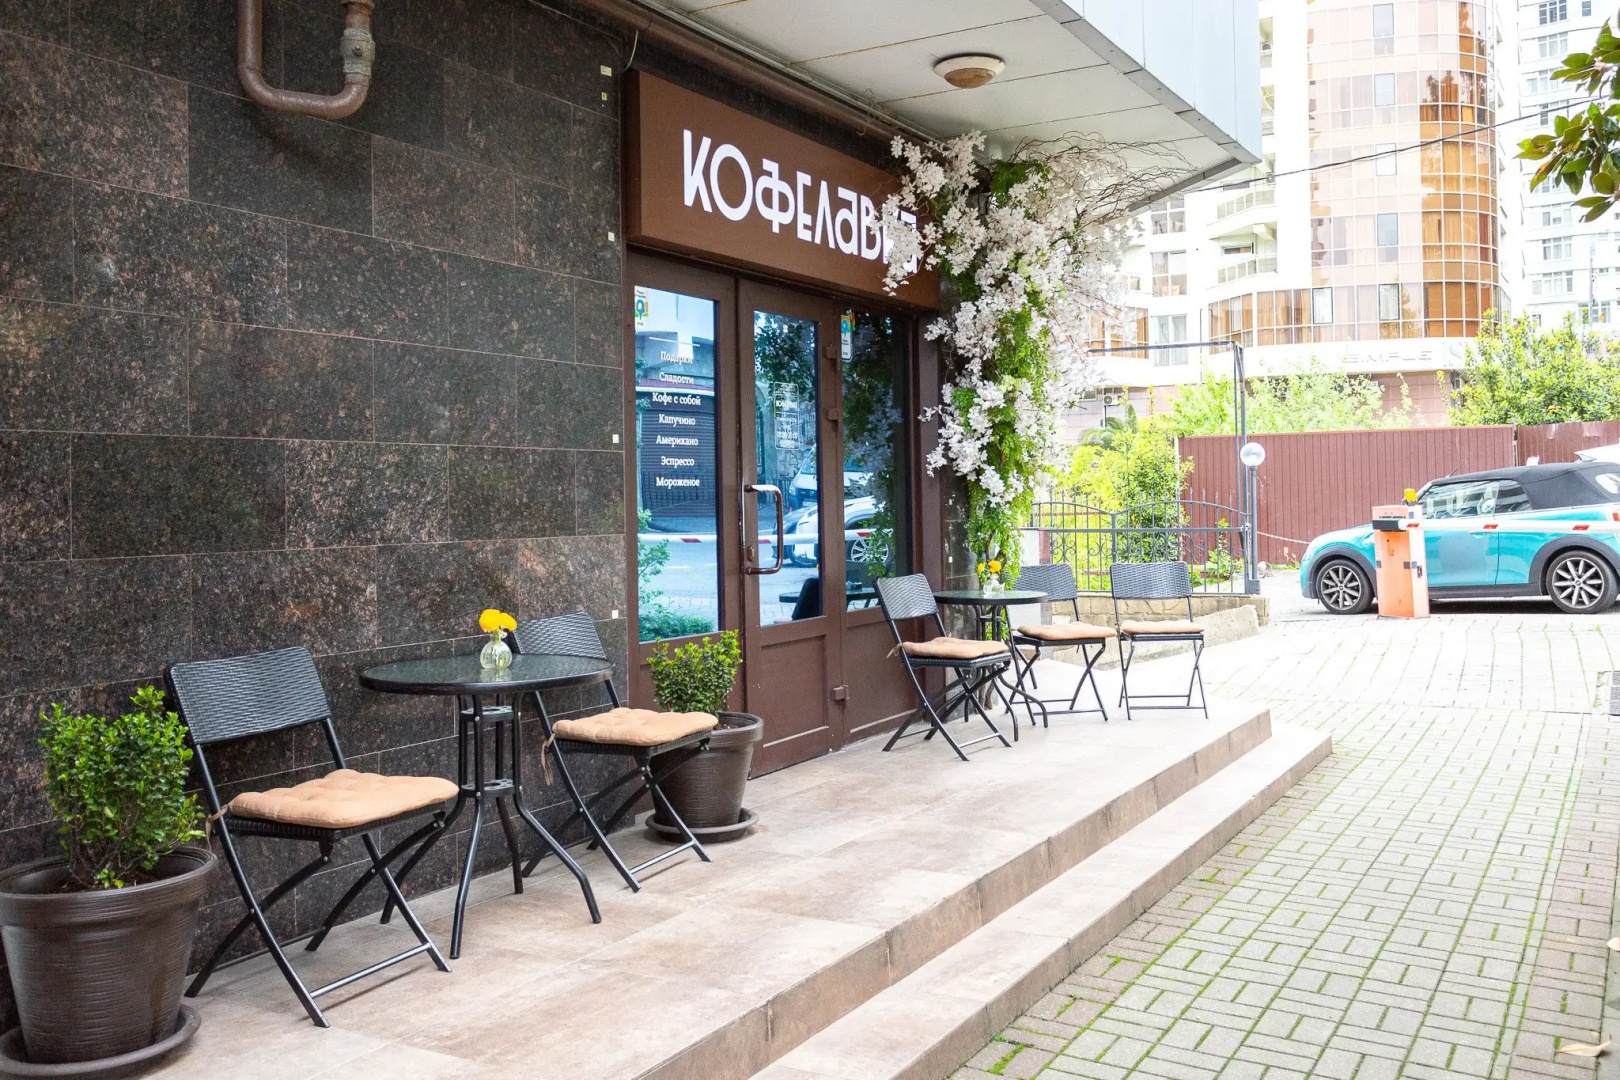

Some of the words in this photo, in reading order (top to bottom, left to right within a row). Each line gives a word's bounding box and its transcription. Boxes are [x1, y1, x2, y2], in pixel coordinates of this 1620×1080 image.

[660, 351, 693, 365] Подарки
[659, 373, 694, 385] Сладости
[652, 392, 672, 404] Кофе
[680, 394, 701, 406] собой
[658, 414, 696, 427] Капучино
[656, 435, 699, 447] Американо
[661, 456, 695, 468] Эспрессо
[655, 476, 700, 489] Мороженое
